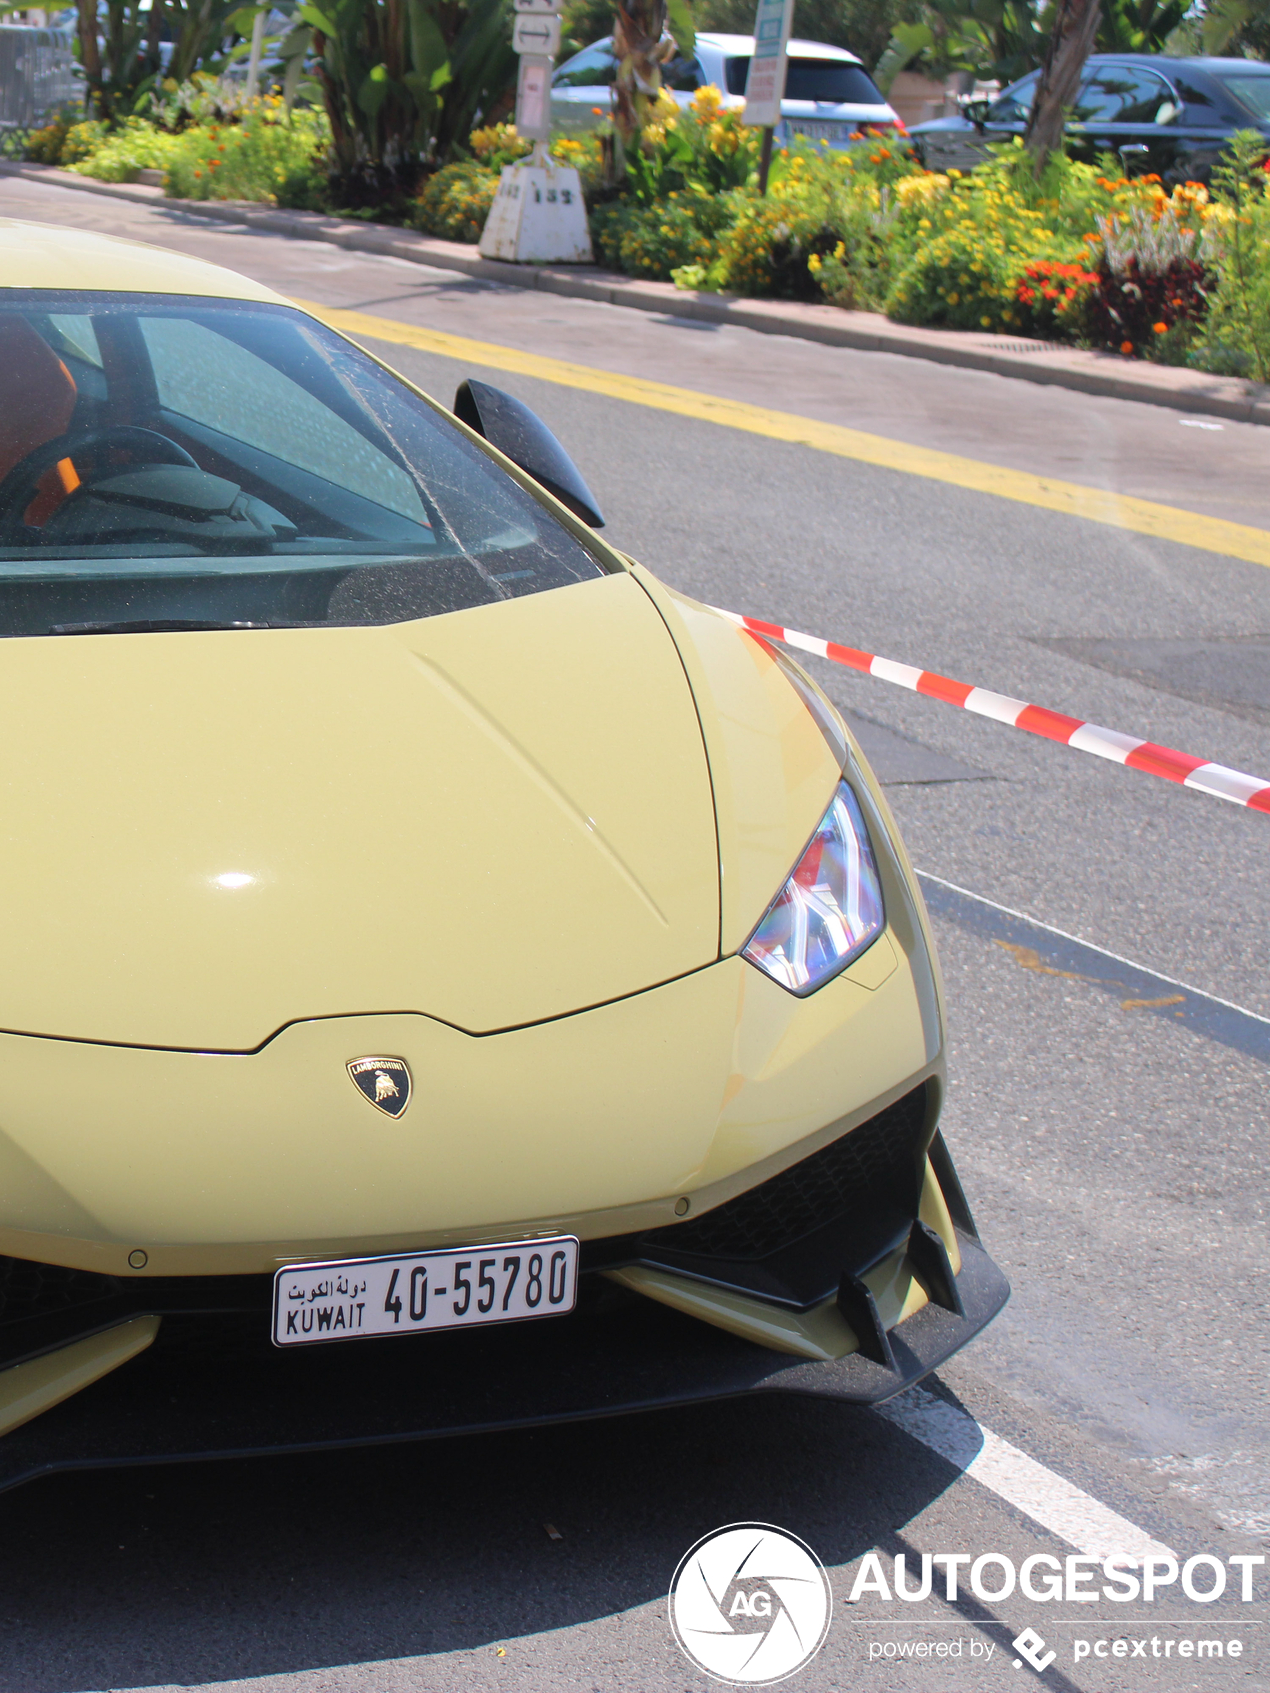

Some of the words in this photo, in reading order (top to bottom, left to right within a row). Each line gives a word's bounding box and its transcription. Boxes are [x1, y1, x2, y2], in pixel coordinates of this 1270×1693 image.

[352, 1061, 403, 1075] LAMBORGHINI
[288, 1280, 333, 1306] الكويت
[336, 1275, 367, 1298] دولة
[384, 1250, 567, 1323] 40-55780
[287, 1303, 366, 1335] KUWAIT
